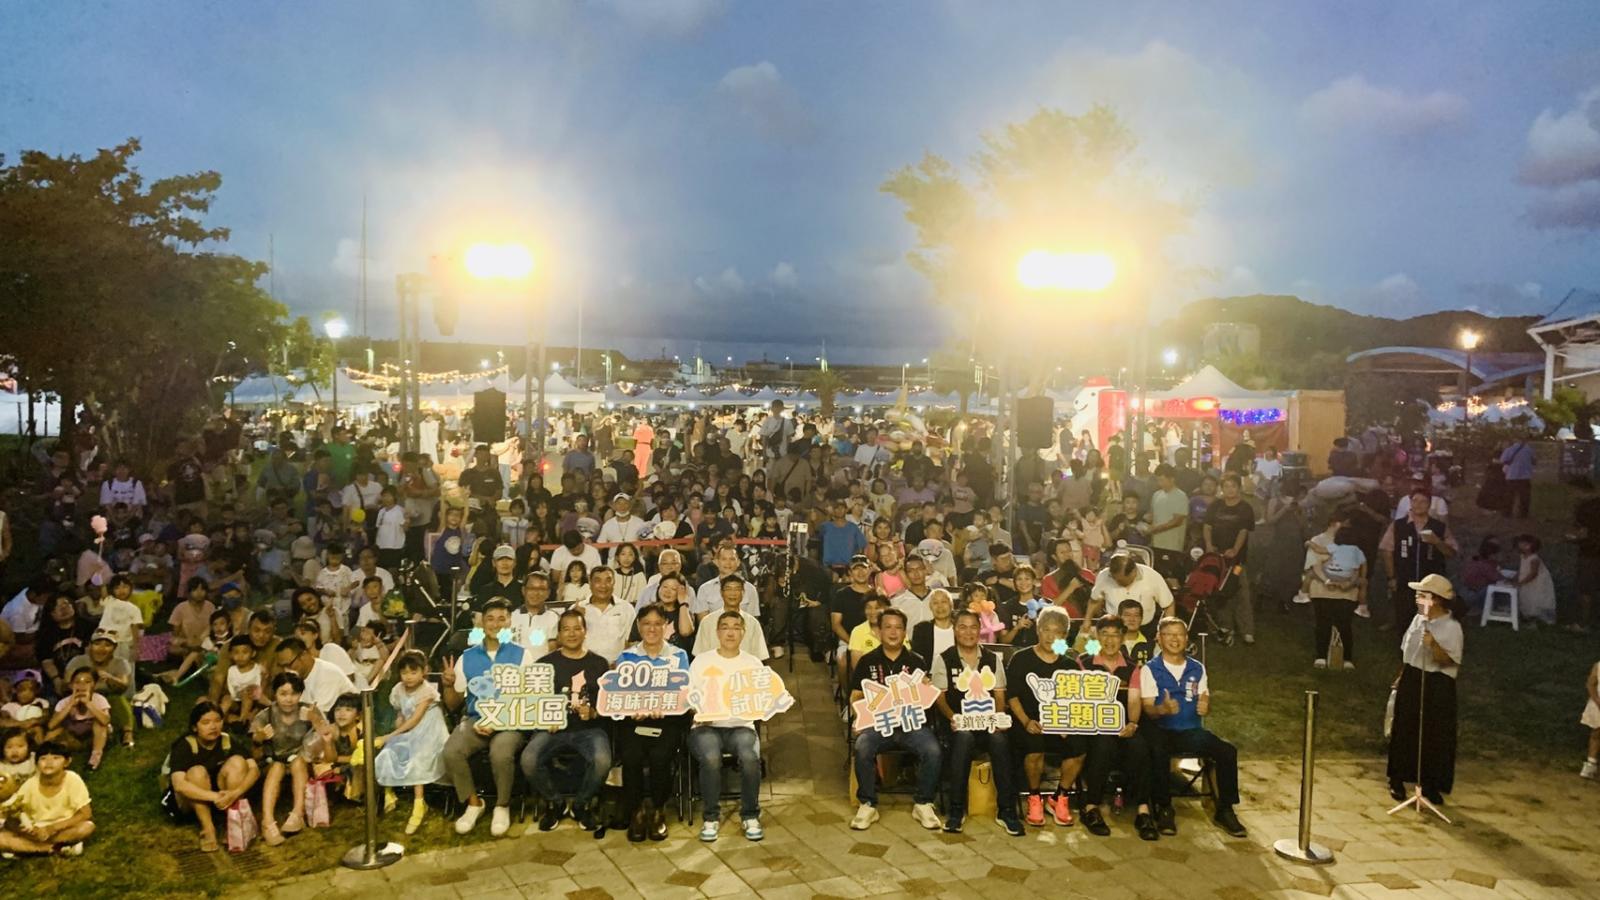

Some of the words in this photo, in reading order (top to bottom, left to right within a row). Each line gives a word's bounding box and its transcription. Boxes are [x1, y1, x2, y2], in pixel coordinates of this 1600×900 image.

[494, 665, 552, 694] 漁業
[863, 669, 924, 710] DIY
[478, 697, 566, 728] 文化區
[606, 692, 679, 711] 海味市集
[730, 693, 773, 715] 試吃
[1042, 702, 1121, 729] 主題日
[875, 704, 925, 735] 手作
